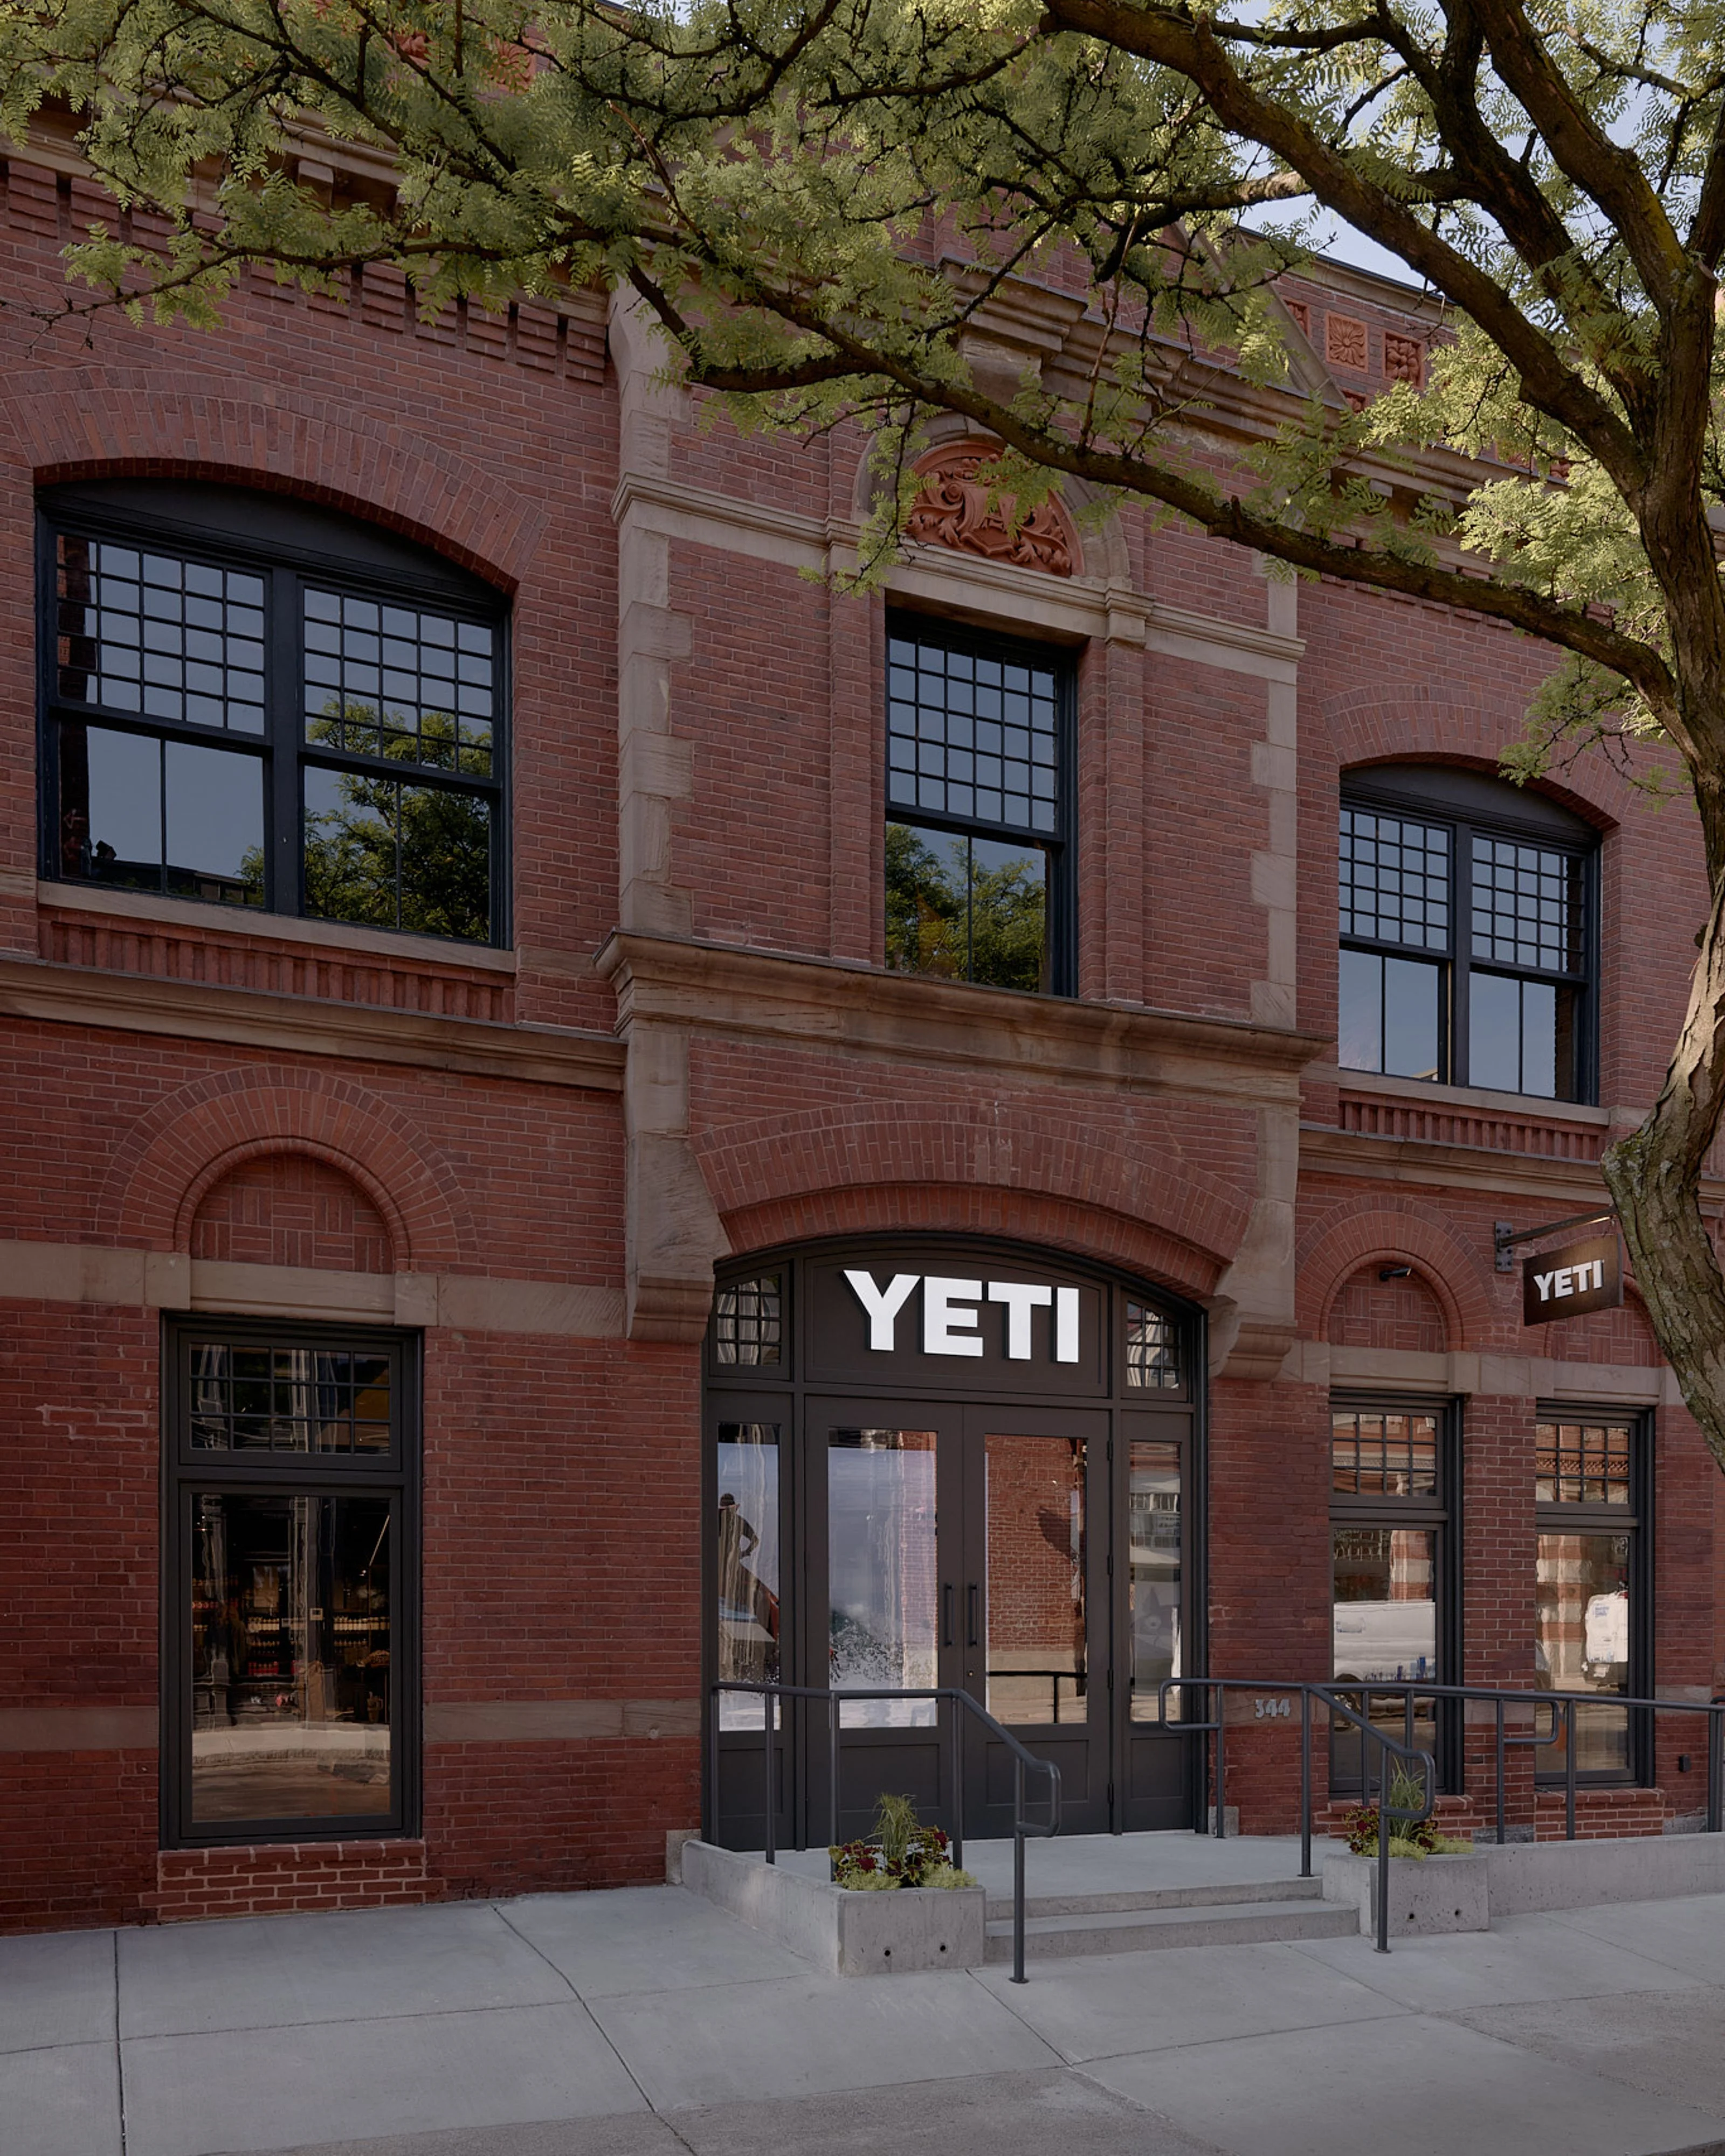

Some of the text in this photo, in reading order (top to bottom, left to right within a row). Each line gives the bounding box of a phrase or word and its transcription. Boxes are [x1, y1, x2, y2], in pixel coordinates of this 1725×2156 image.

[1533, 1260, 1603, 1302] YETI
[843, 1269, 1079, 1363] YETI
[1255, 1698, 1291, 1718] 344
